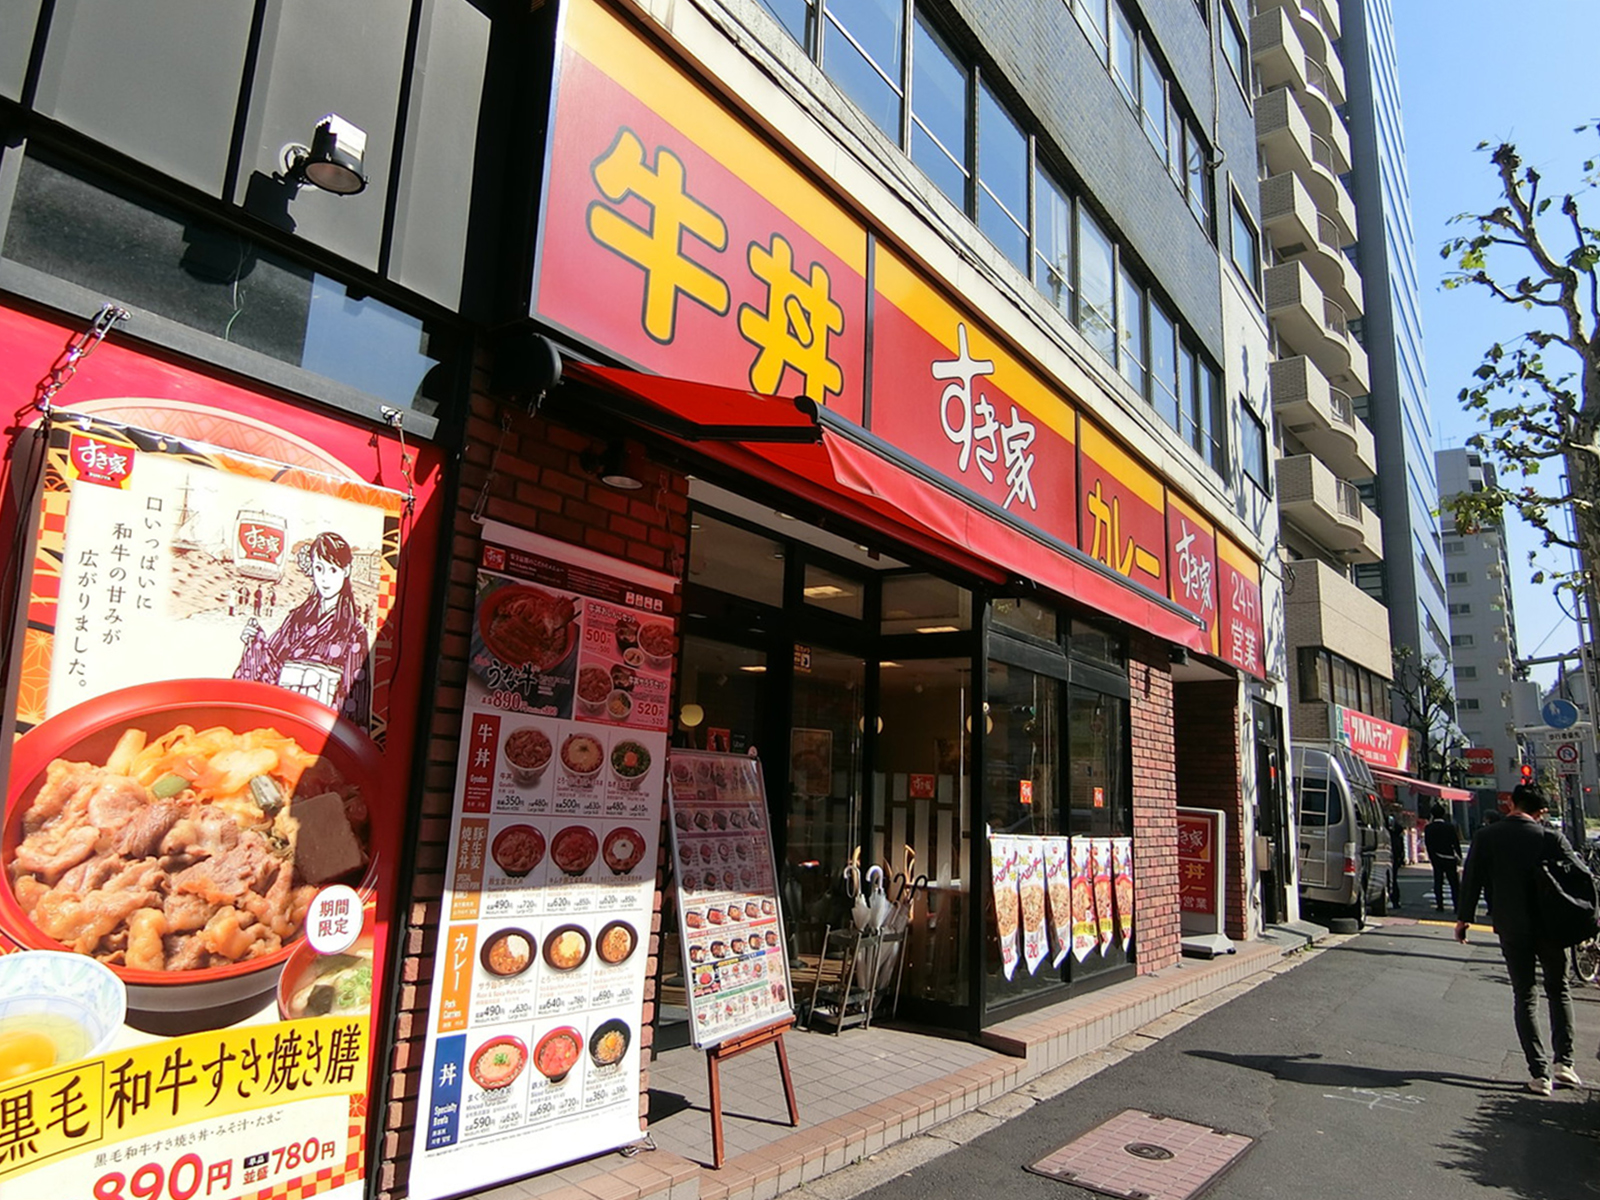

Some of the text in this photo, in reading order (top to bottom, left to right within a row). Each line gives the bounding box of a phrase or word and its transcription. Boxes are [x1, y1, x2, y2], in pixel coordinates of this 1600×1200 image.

[586, 126, 844, 405] 牛丼
[931, 322, 1038, 511] すき家
[78, 438, 127, 476] すき家
[244, 525, 281, 554] すき家
[1087, 478, 1161, 579] カレー
[136, 496, 163, 610] 口いっぱいに
[1175, 519, 1213, 614] すき家
[102, 522, 133, 646] 和牛の甘みが
[1231, 571, 1256, 622] 24H
[69, 550, 99, 688] 広がりました。
[1231, 618, 1257, 672] 営業
[487, 658, 538, 696] うな牛
[474, 723, 493, 768] 牛丼
[1178, 824, 1204, 848] き家
[1179, 863, 1206, 880] 丼
[317, 917, 350, 937] 限定
[319, 898, 350, 918] 期間
[453, 932, 469, 992] カレー
[439, 1062, 457, 1087] 丼
[271, 1137, 336, 1175] 780円
